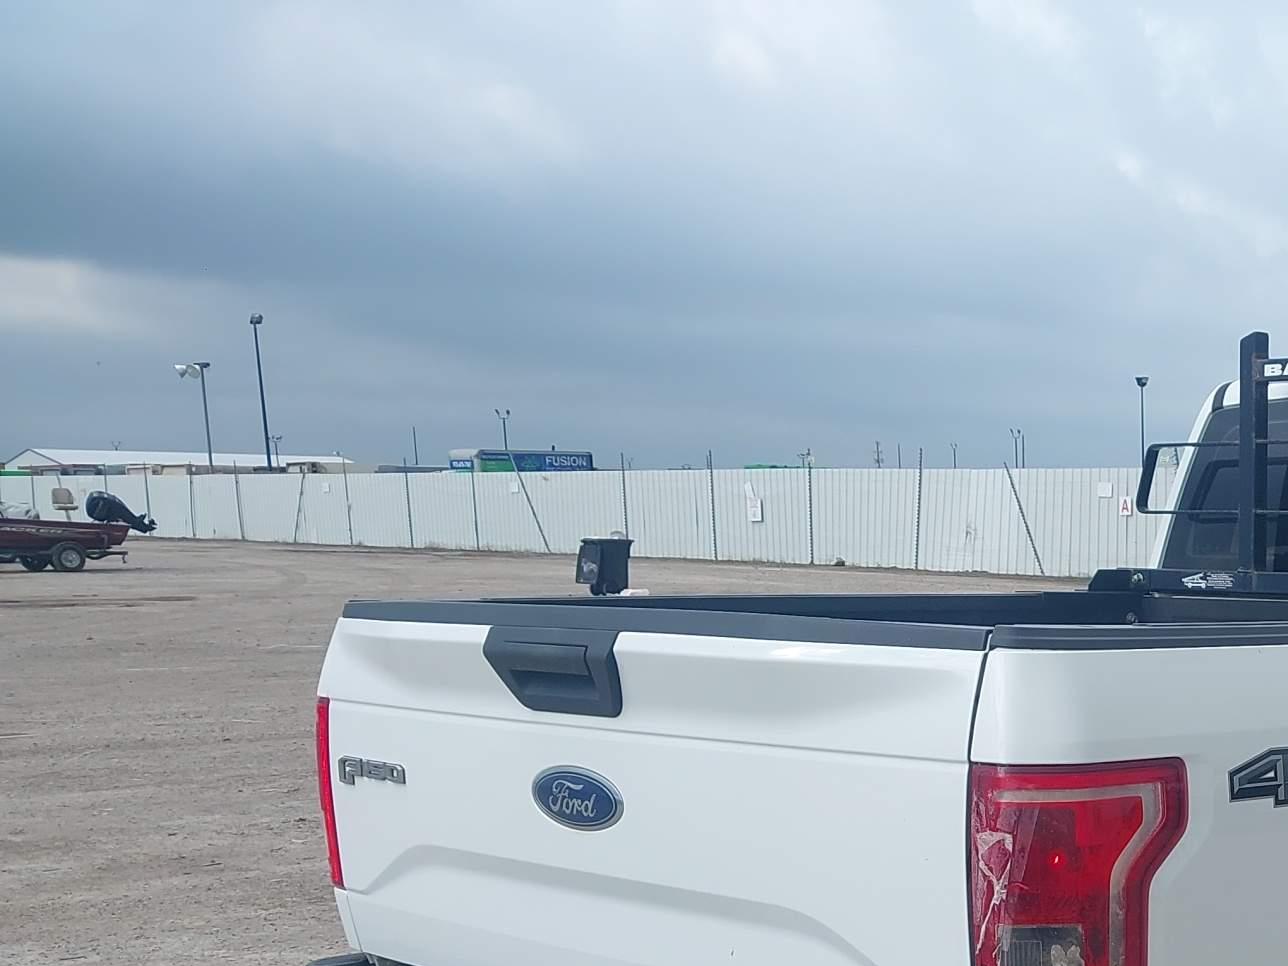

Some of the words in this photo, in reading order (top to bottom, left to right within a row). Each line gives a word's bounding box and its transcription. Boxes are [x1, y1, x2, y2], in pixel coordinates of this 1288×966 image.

[545, 456, 587, 467] FUSION
[1121, 498, 1130, 513] A
[549, 779, 597, 817] Ford
